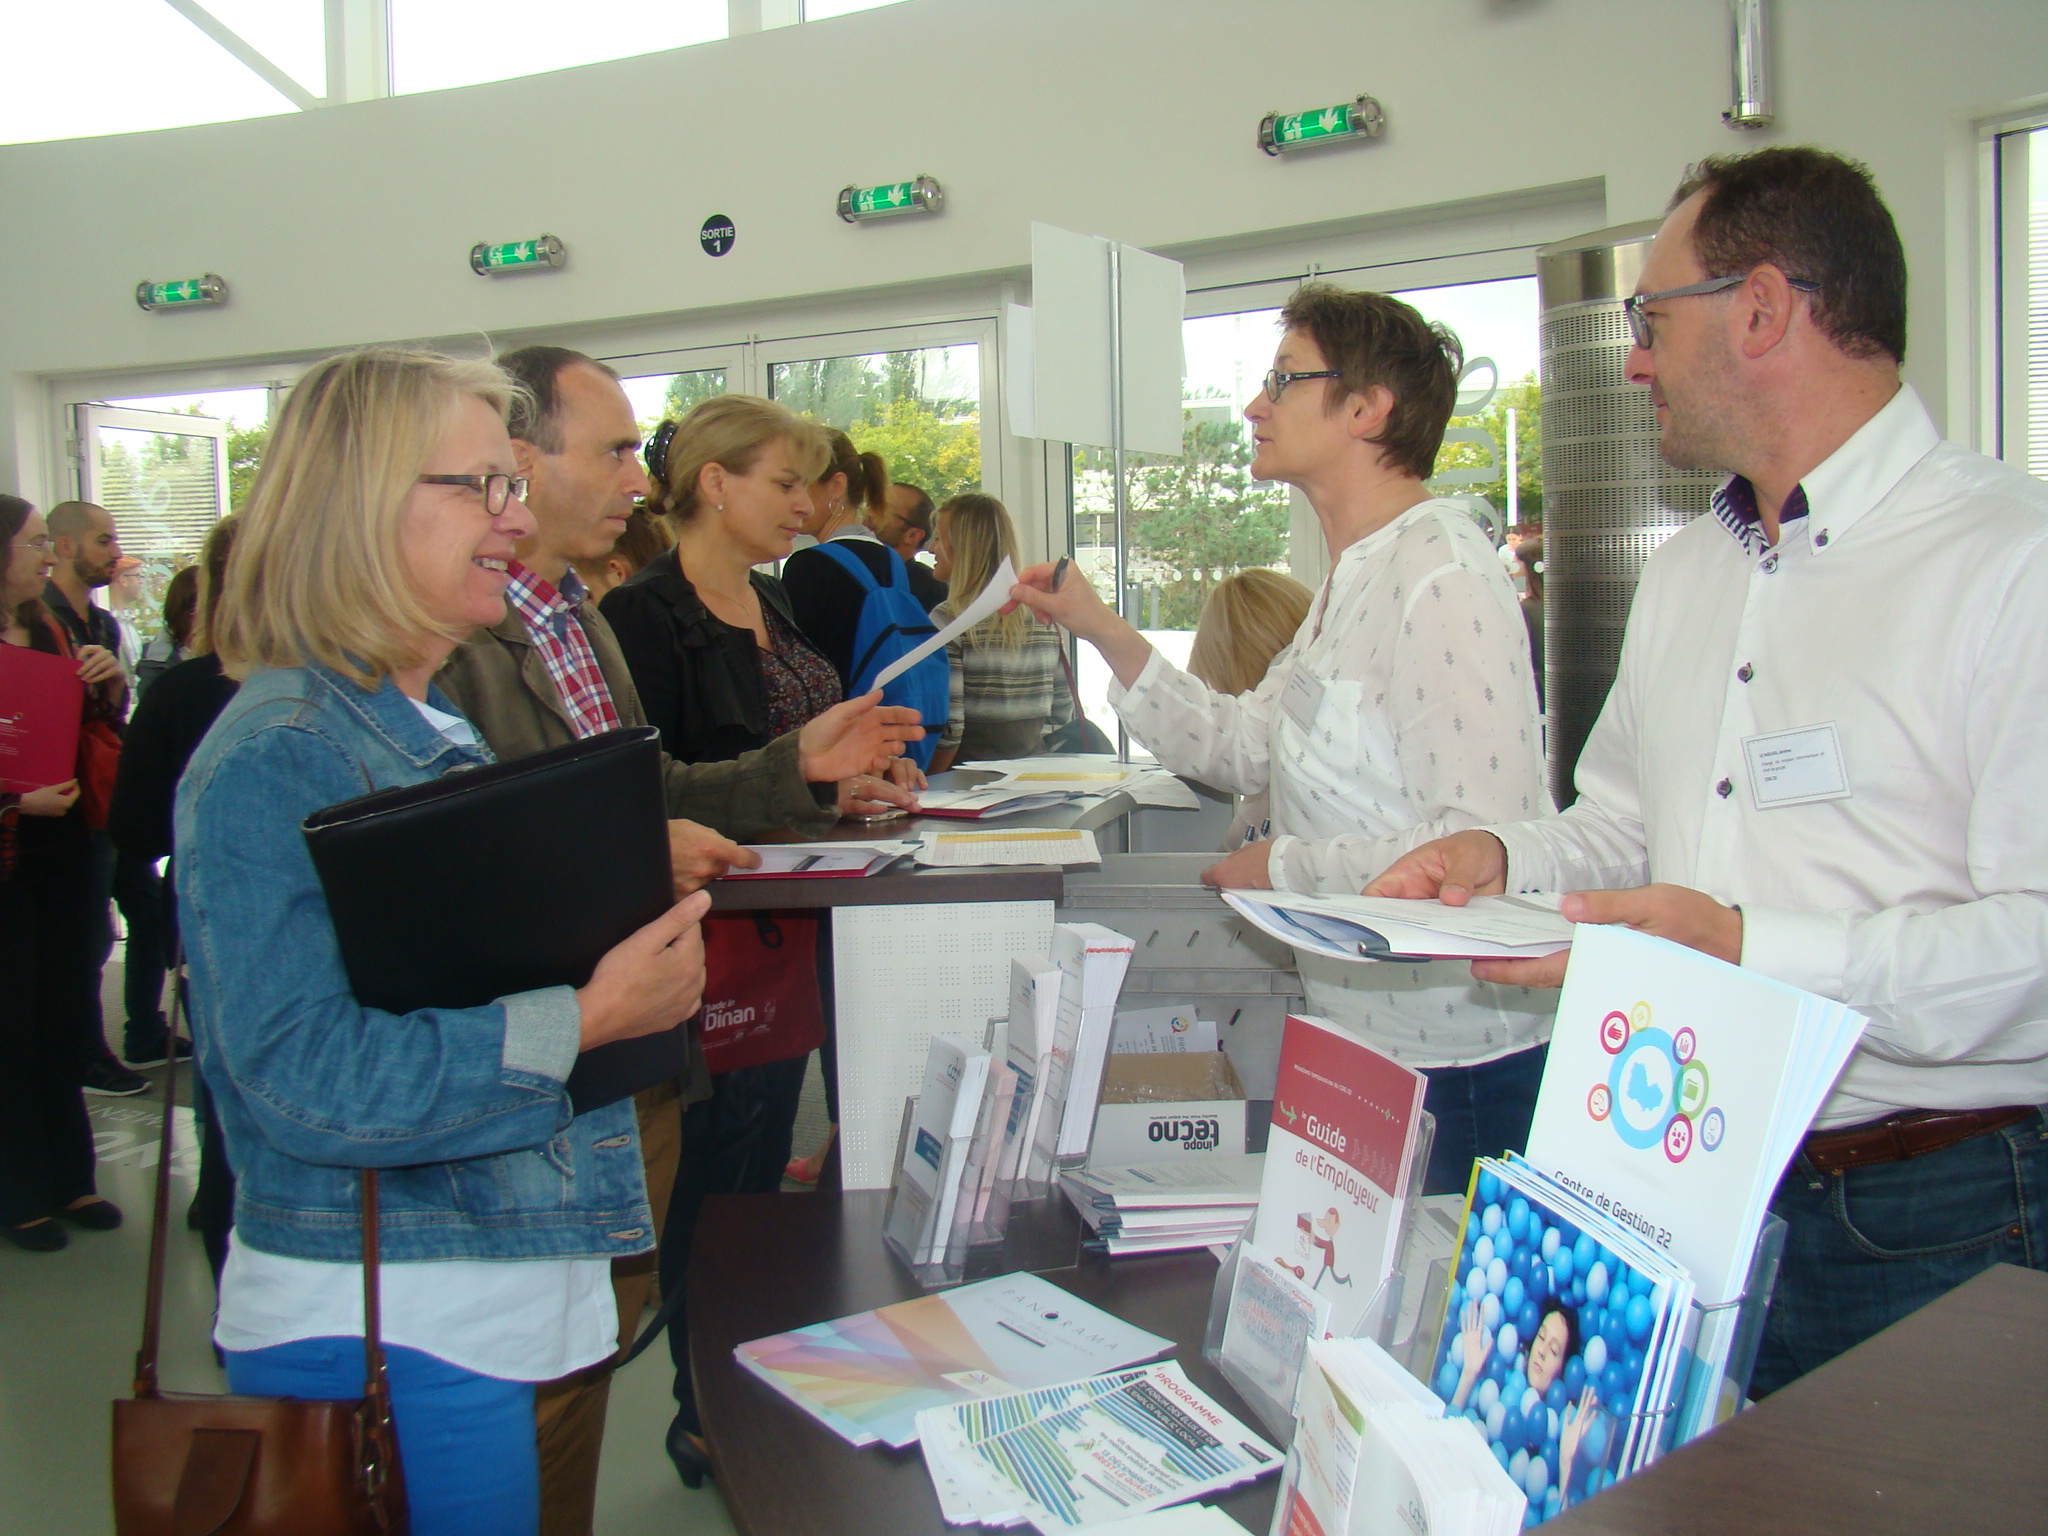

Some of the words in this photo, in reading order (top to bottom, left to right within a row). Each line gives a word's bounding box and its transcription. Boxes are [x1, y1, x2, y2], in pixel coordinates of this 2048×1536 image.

[702, 227, 734, 240] SORTIE
[713, 240, 721, 253] 1
[705, 1006, 755, 1032] Dinan
[1148, 1119, 1219, 1148] tecno
[1306, 1115, 1346, 1153] Guide
[1295, 1149, 1308, 1167] de
[1310, 1154, 1379, 1213] l'Employeur
[1595, 1192, 1610, 1212] de
[1612, 1201, 1655, 1240] Gestion
[1656, 1228, 1672, 1250] 22
[1002, 1289, 1119, 1349] PANORAMA
[1154, 1372, 1223, 1426] PROGRAMME
